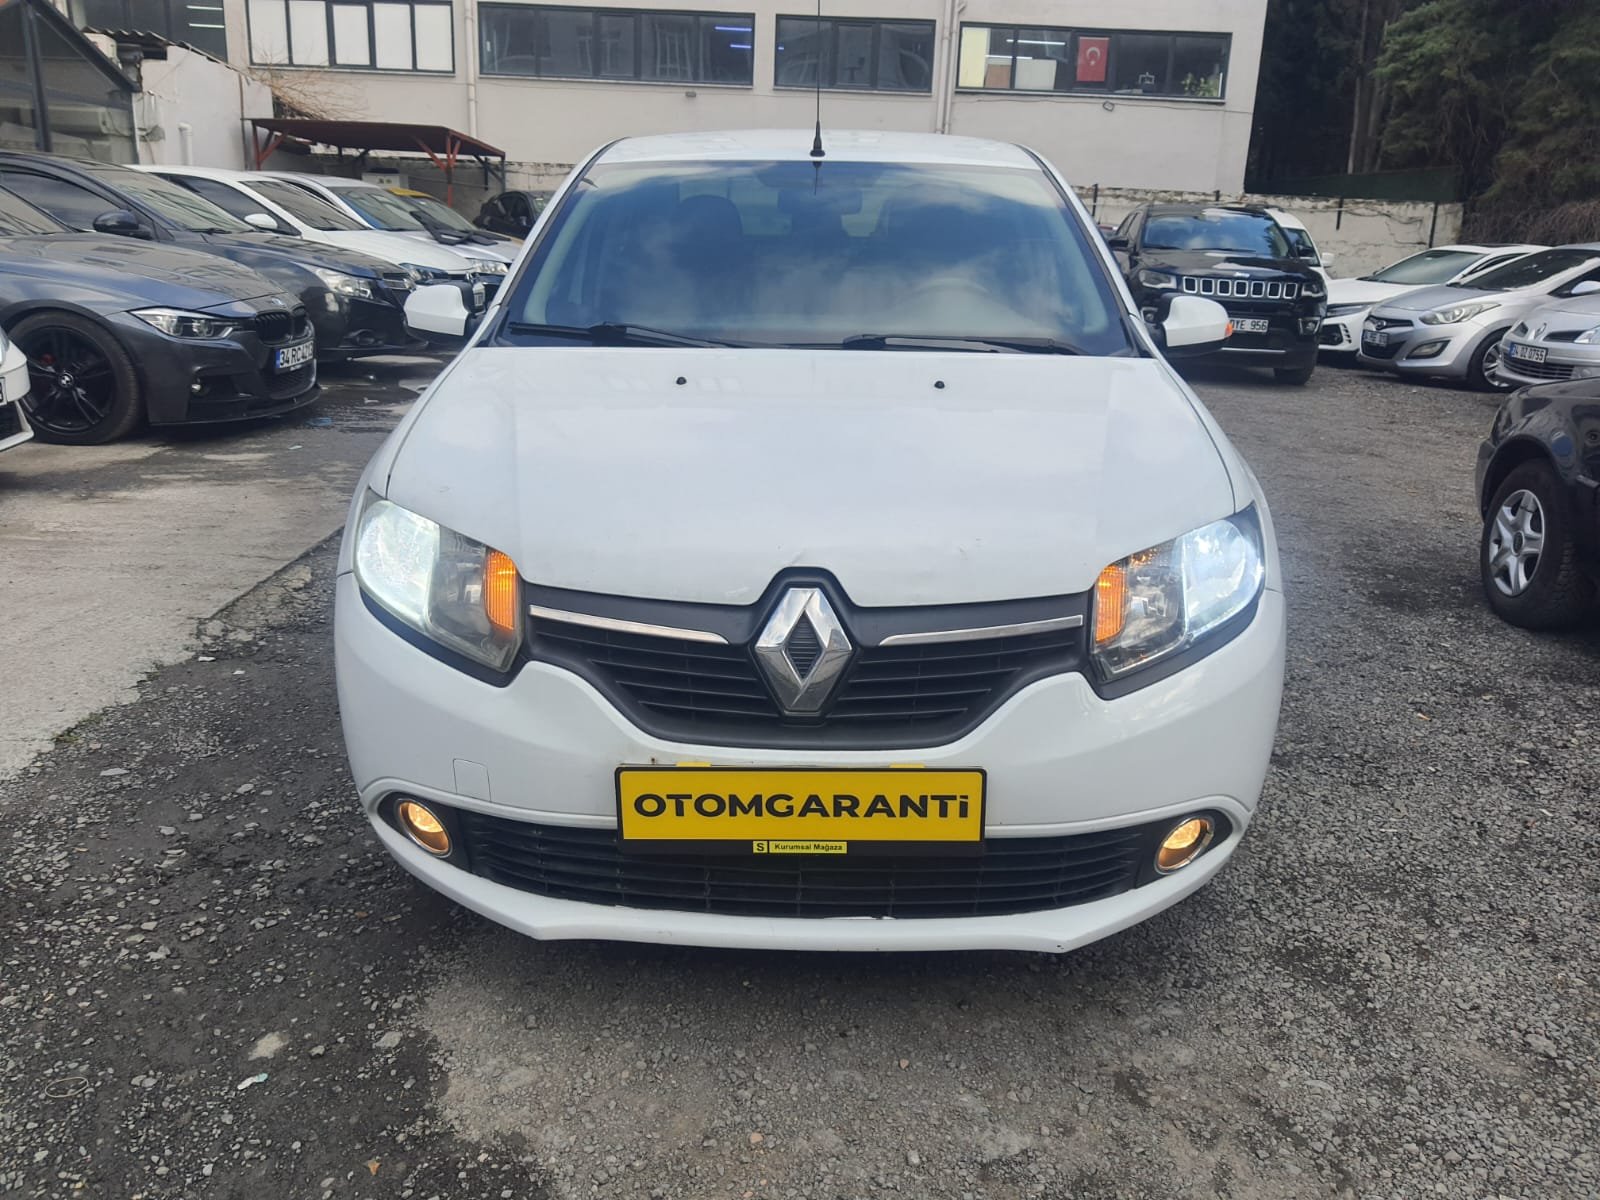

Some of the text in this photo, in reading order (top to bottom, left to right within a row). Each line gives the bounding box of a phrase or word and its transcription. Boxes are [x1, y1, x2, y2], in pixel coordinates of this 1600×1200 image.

[1250, 320, 1267, 331] 956
[280, 350, 290, 366] 34
[756, 842, 843, 852] S Kurumsal Mağaza
